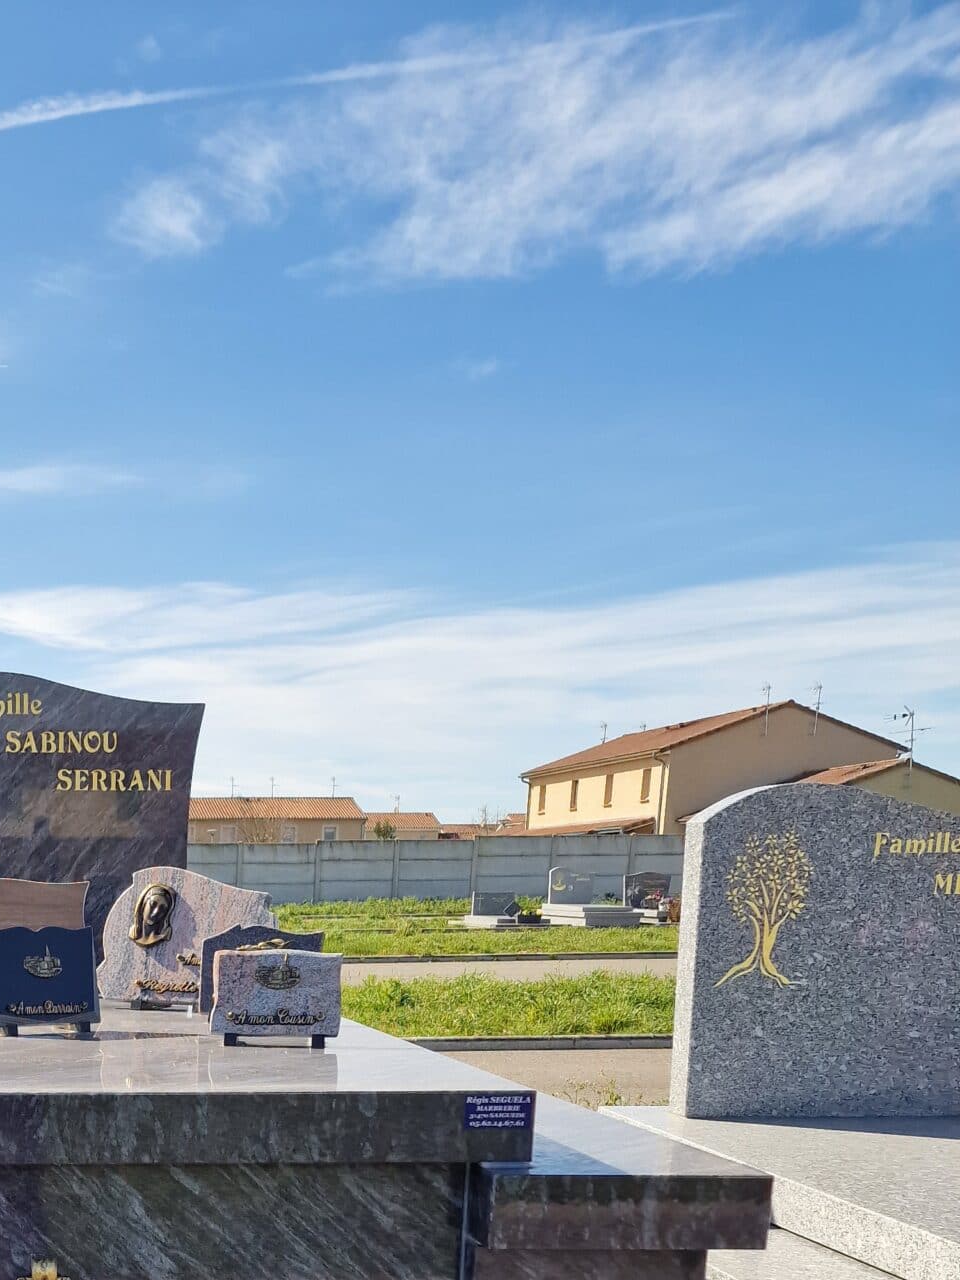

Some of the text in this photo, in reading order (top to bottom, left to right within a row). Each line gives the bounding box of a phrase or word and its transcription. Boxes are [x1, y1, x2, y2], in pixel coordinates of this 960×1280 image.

[5, 730, 119, 755] SABINOU
[56, 768, 173, 792] SERRANI
[872, 831, 960, 863] Famille
[44, 1000, 81, 1014] Parrain
[235, 1008, 316, 1025] A mon Cousin
